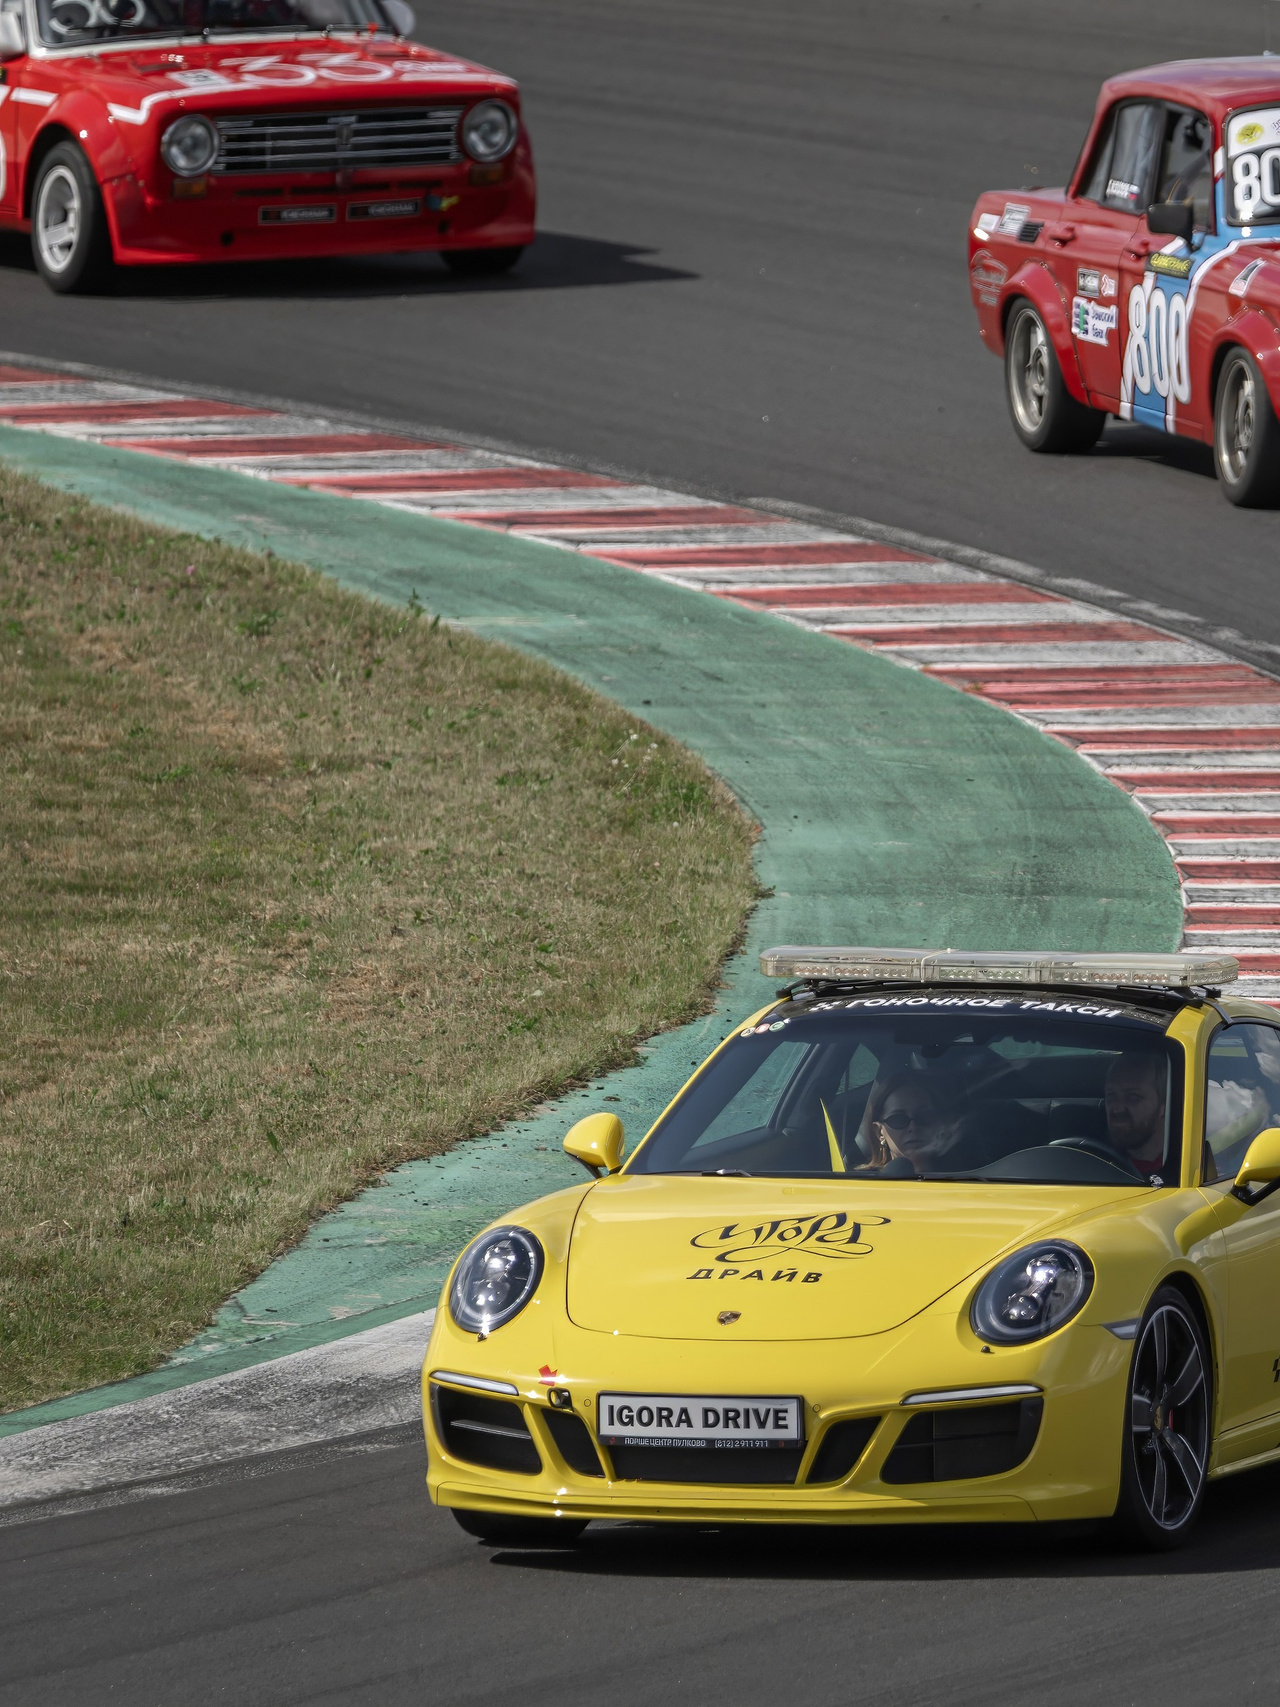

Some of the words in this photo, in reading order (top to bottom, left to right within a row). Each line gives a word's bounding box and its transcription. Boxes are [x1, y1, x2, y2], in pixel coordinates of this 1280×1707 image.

[1128, 284, 1191, 405] 800
[845, 997, 1014, 1008] ГОНОЧНОЕ
[1020, 1000, 1122, 1018] ТАКСИ
[686, 1267, 823, 1283] ДРАЙВ
[607, 1404, 693, 1428] IGORA
[701, 1407, 789, 1429] DRIVE
